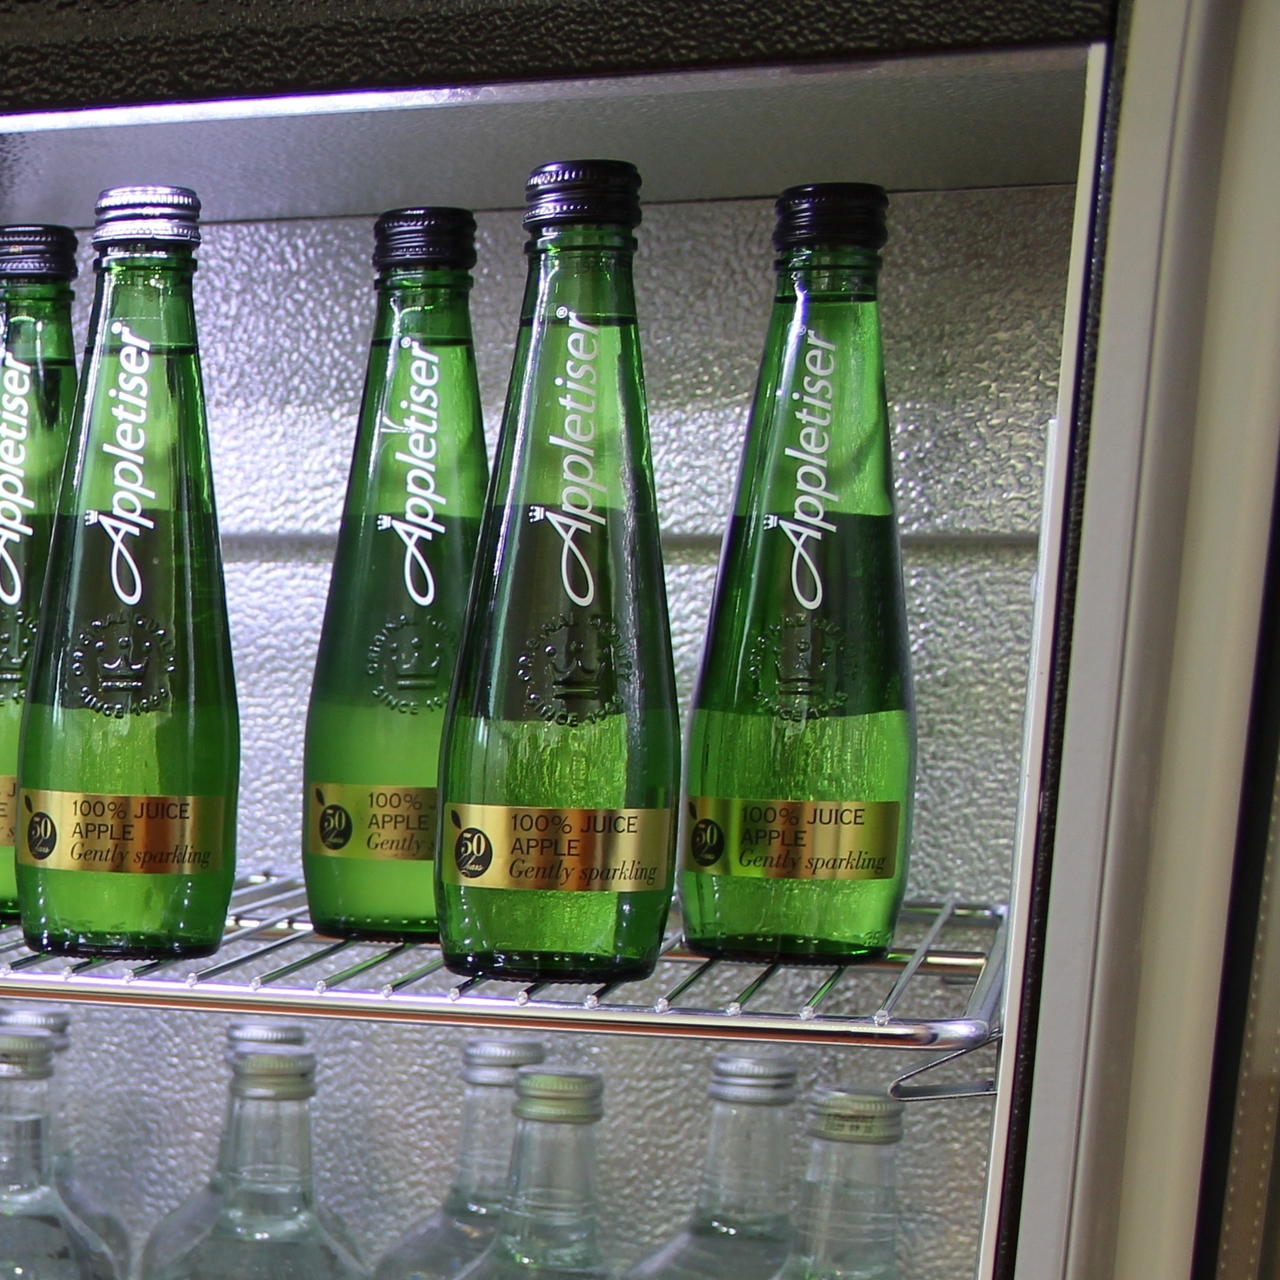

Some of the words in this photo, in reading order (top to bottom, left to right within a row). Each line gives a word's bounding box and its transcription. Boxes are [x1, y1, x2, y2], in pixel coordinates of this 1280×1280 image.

[92, 323, 157, 607] Appletiser
[540, 308, 608, 608] Appletiser
[772, 327, 840, 611] Appletiser
[385, 338, 447, 608] Appletiser
[72, 800, 127, 820] 100%
[134, 803, 190, 820] JUICE
[368, 792, 423, 811] 100%
[324, 809, 346, 832] 50
[367, 813, 431, 831] APPLE
[512, 813, 573, 835] 100%
[580, 815, 639, 834] JUICE
[742, 806, 799, 826] 100%
[806, 808, 866, 826] JUICE
[31, 816, 52, 840] 50
[71, 823, 135, 842] APPLE
[696, 824, 718, 846] 50
[741, 829, 807, 848] APPLE
[70, 842, 129, 869] Gently
[133, 845, 212, 870] sparkling
[366, 831, 423, 858] Gently
[460, 832, 487, 857] 50
[510, 837, 581, 858] APPLE
[508, 858, 575, 887] Gently
[579, 862, 658, 890] sparkling
[738, 850, 802, 876] Gently
[804, 851, 887, 875] sparkling
